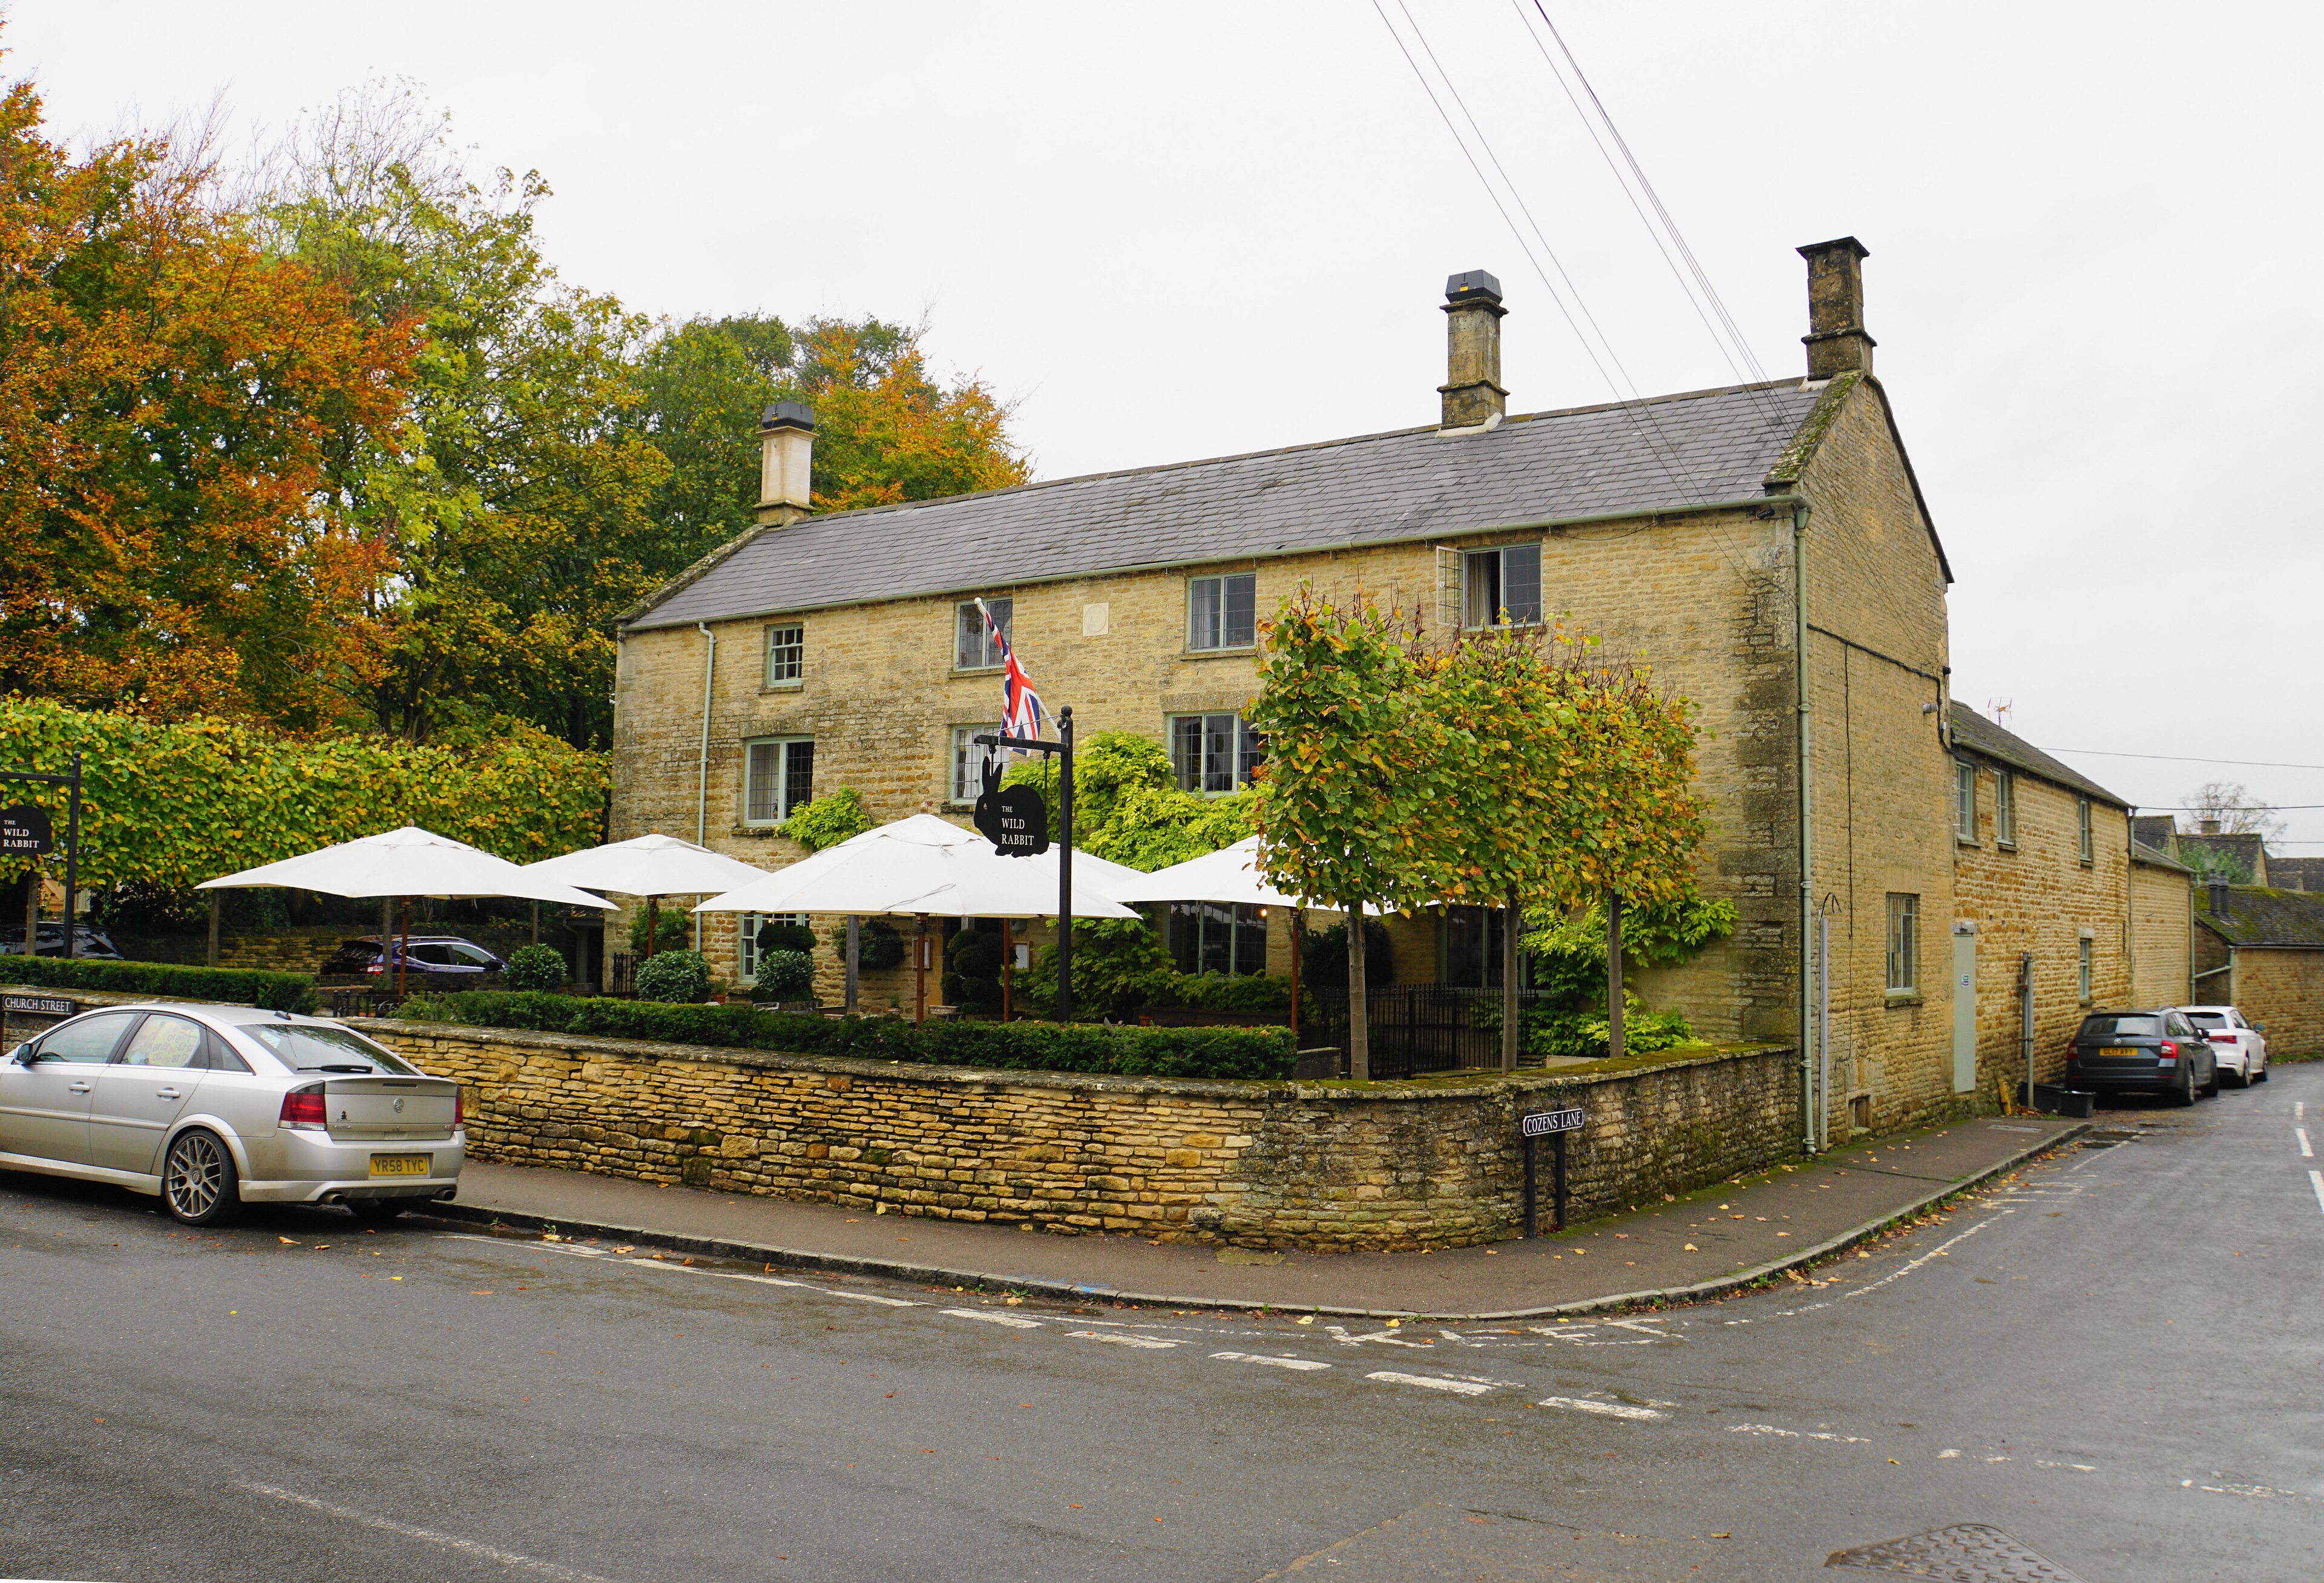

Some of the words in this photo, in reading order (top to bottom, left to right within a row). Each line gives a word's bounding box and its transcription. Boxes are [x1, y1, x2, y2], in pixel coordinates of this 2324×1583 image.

[1002, 818, 1025, 829] WILD
[4, 828, 29, 837] WILD
[2, 839, 39, 848] RABBIT
[1002, 834, 1034, 846] RABBIT
[5, 997, 38, 1010] CHURCH
[41, 999, 71, 1012] STREET
[1527, 1115, 1558, 1133] COZENS
[1561, 1111, 1581, 1128] LANE
[374, 1160, 402, 1173] YR58
[405, 1159, 424, 1172] TYC
